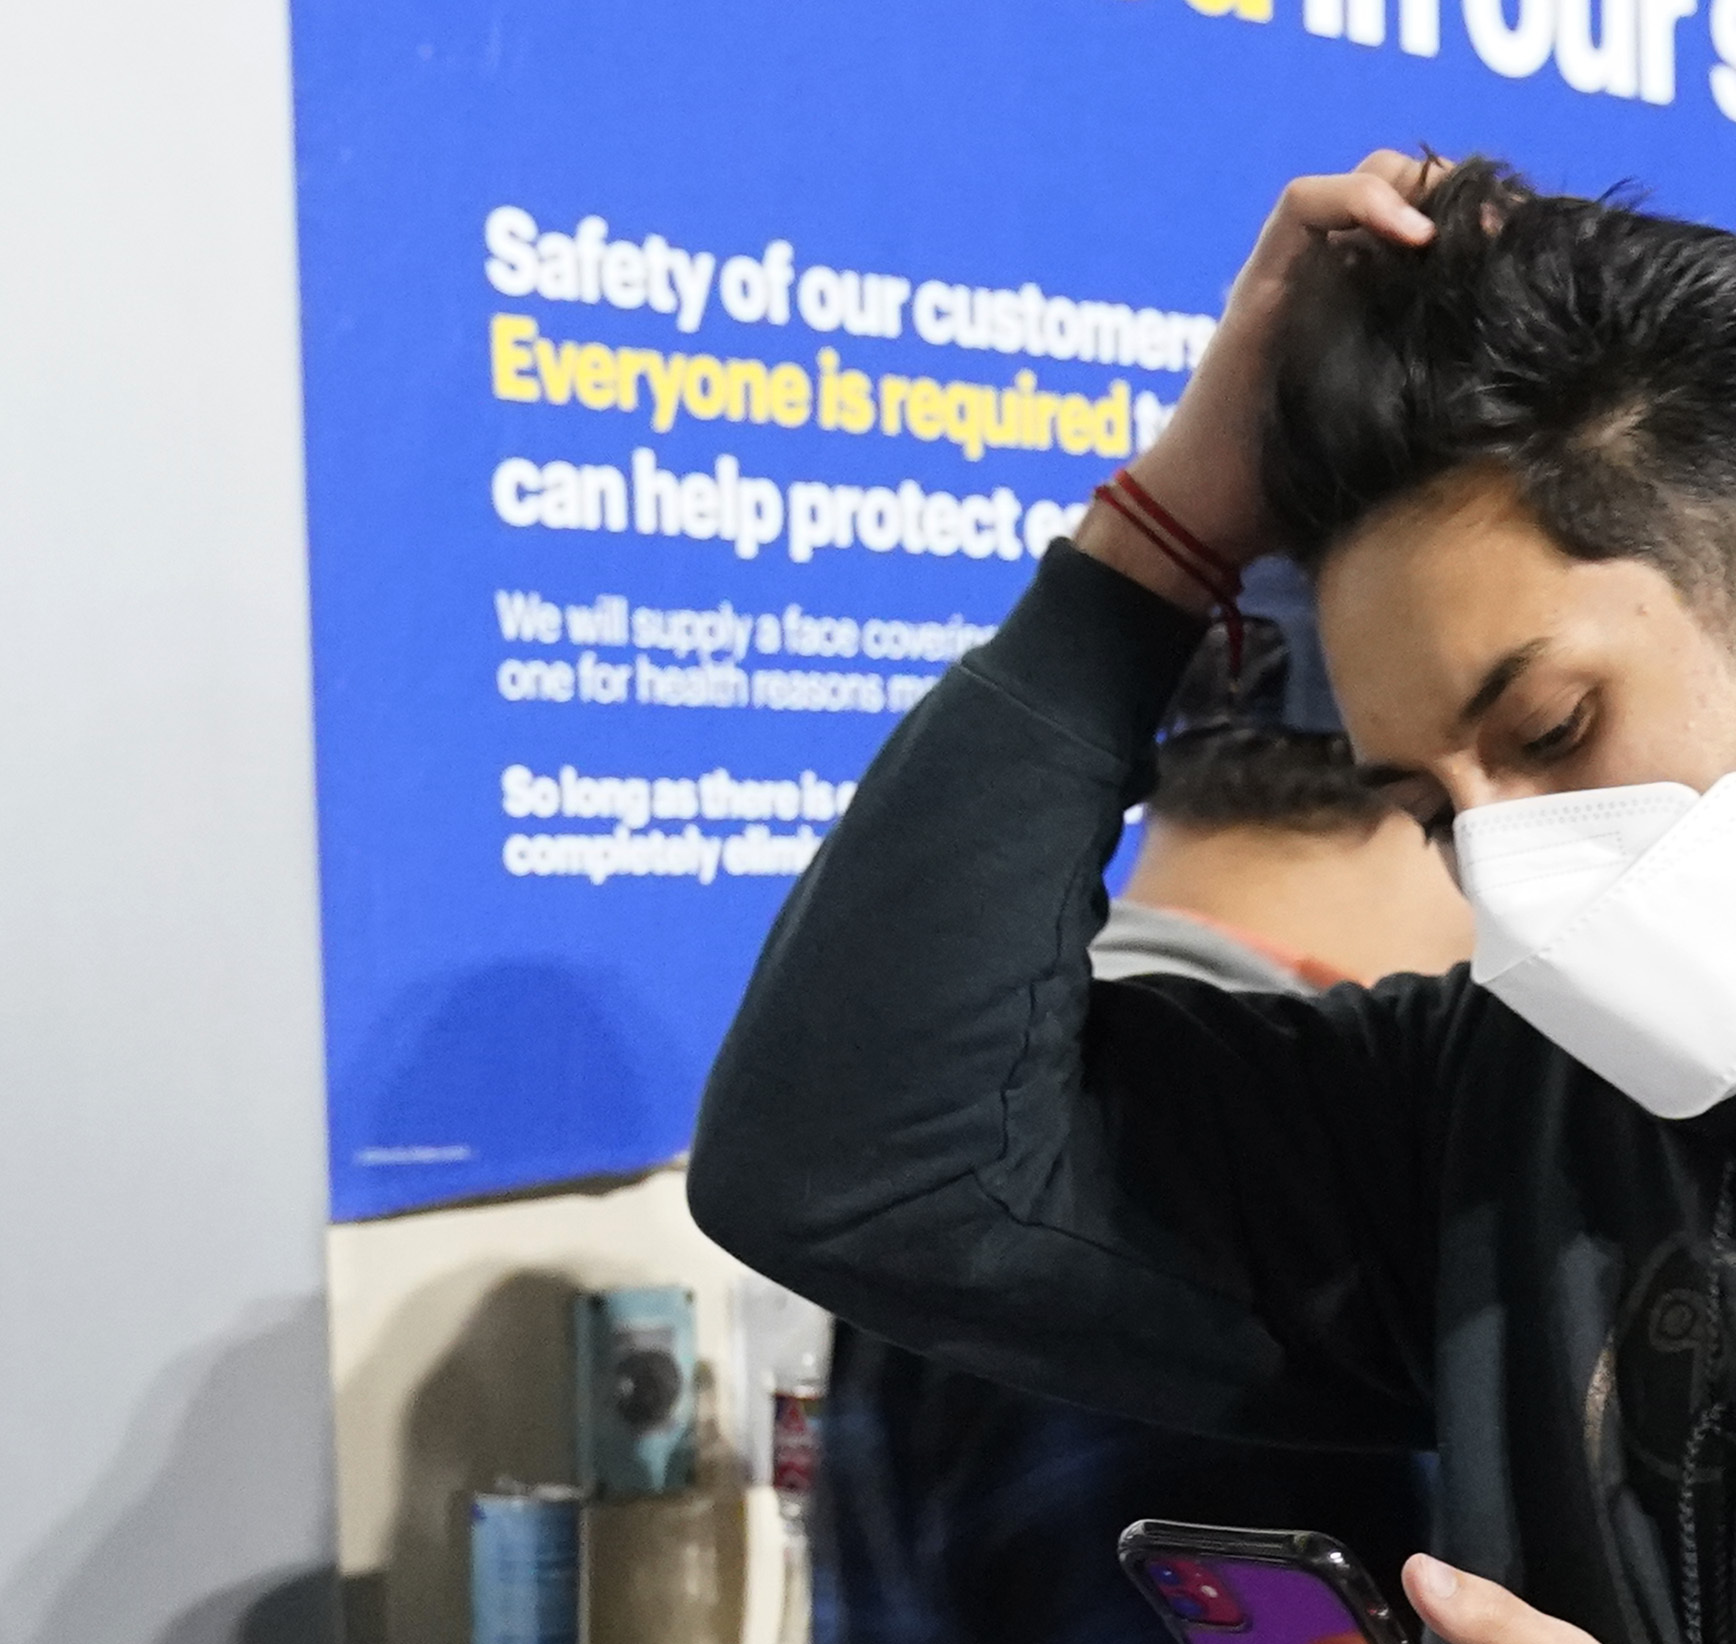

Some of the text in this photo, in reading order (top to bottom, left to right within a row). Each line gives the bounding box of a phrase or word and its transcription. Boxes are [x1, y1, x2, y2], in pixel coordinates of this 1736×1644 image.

[485, 206, 716, 333] Safety
[719, 240, 796, 325] of
[797, 266, 911, 339] our
[490, 312, 813, 433] Everyone
[817, 347, 877, 434] is
[879, 369, 1131, 461] required
[492, 458, 628, 532] can
[632, 447, 784, 559] help
[788, 479, 1023, 563] protect
[496, 590, 563, 644] We
[565, 595, 629, 646] will
[631, 600, 754, 667] supply
[755, 613, 782, 654] a
[783, 604, 861, 657] face
[498, 659, 575, 703] one
[577, 651, 632, 704] for
[634, 653, 750, 708] health
[751, 670, 887, 713] reasons
[502, 764, 560, 818] So
[559, 765, 651, 830] long
[652, 777, 699, 820] as
[698, 767, 800, 821] there
[502, 823, 723, 886] completely
